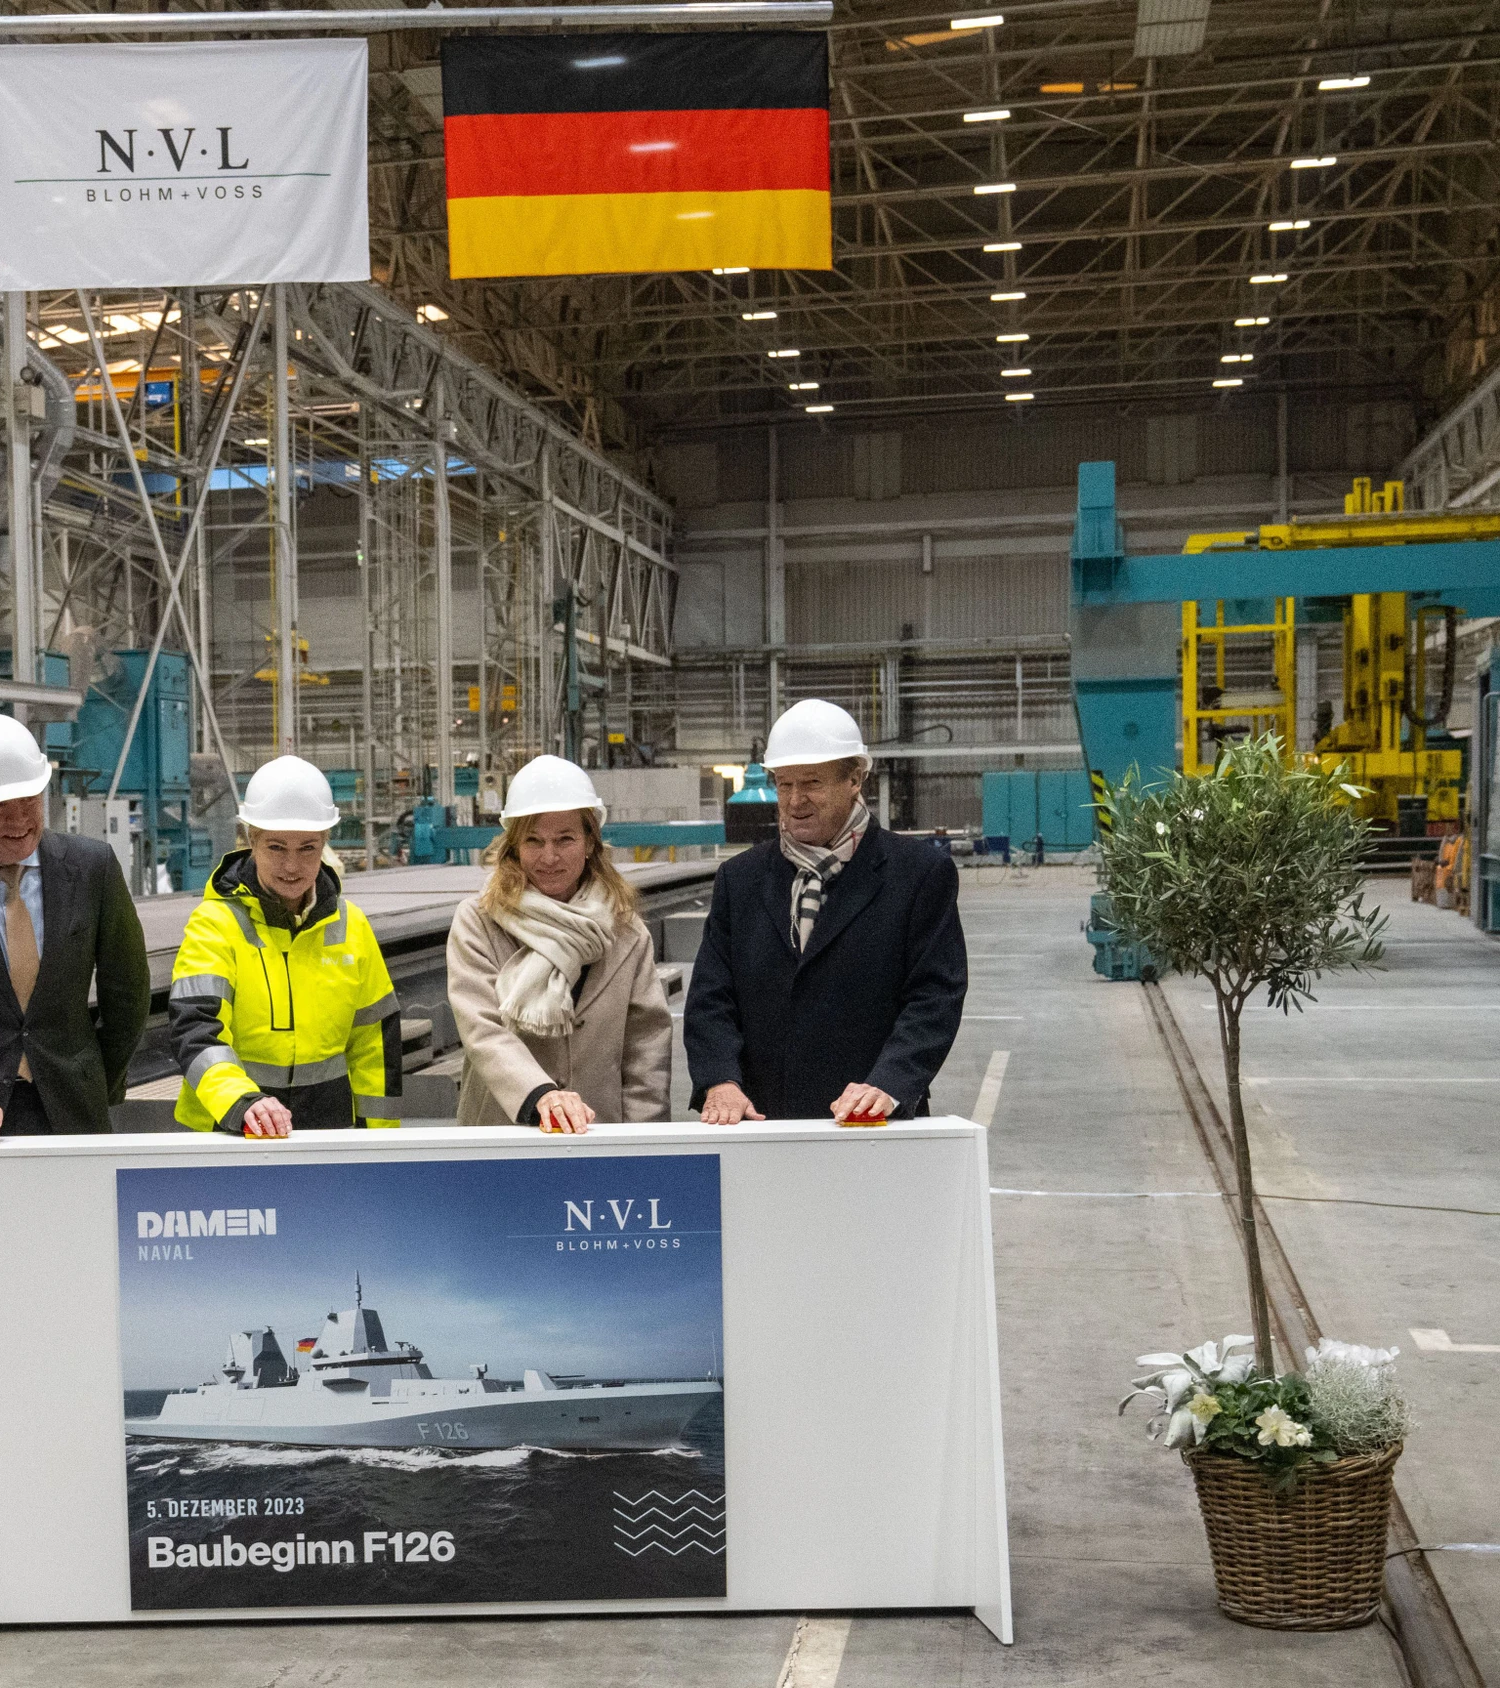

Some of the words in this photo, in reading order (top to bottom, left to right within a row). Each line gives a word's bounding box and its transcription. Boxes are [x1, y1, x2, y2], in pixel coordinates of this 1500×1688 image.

[137, 1208, 277, 1238] DAMEN
[138, 1244, 194, 1261] NAVAL
[147, 1501, 163, 1518] 5.
[168, 1498, 258, 1518] DEZEMBER
[264, 1497, 305, 1516] 2023
[148, 1533, 355, 1572] Baubeginn
[363, 1530, 456, 1563] F126
